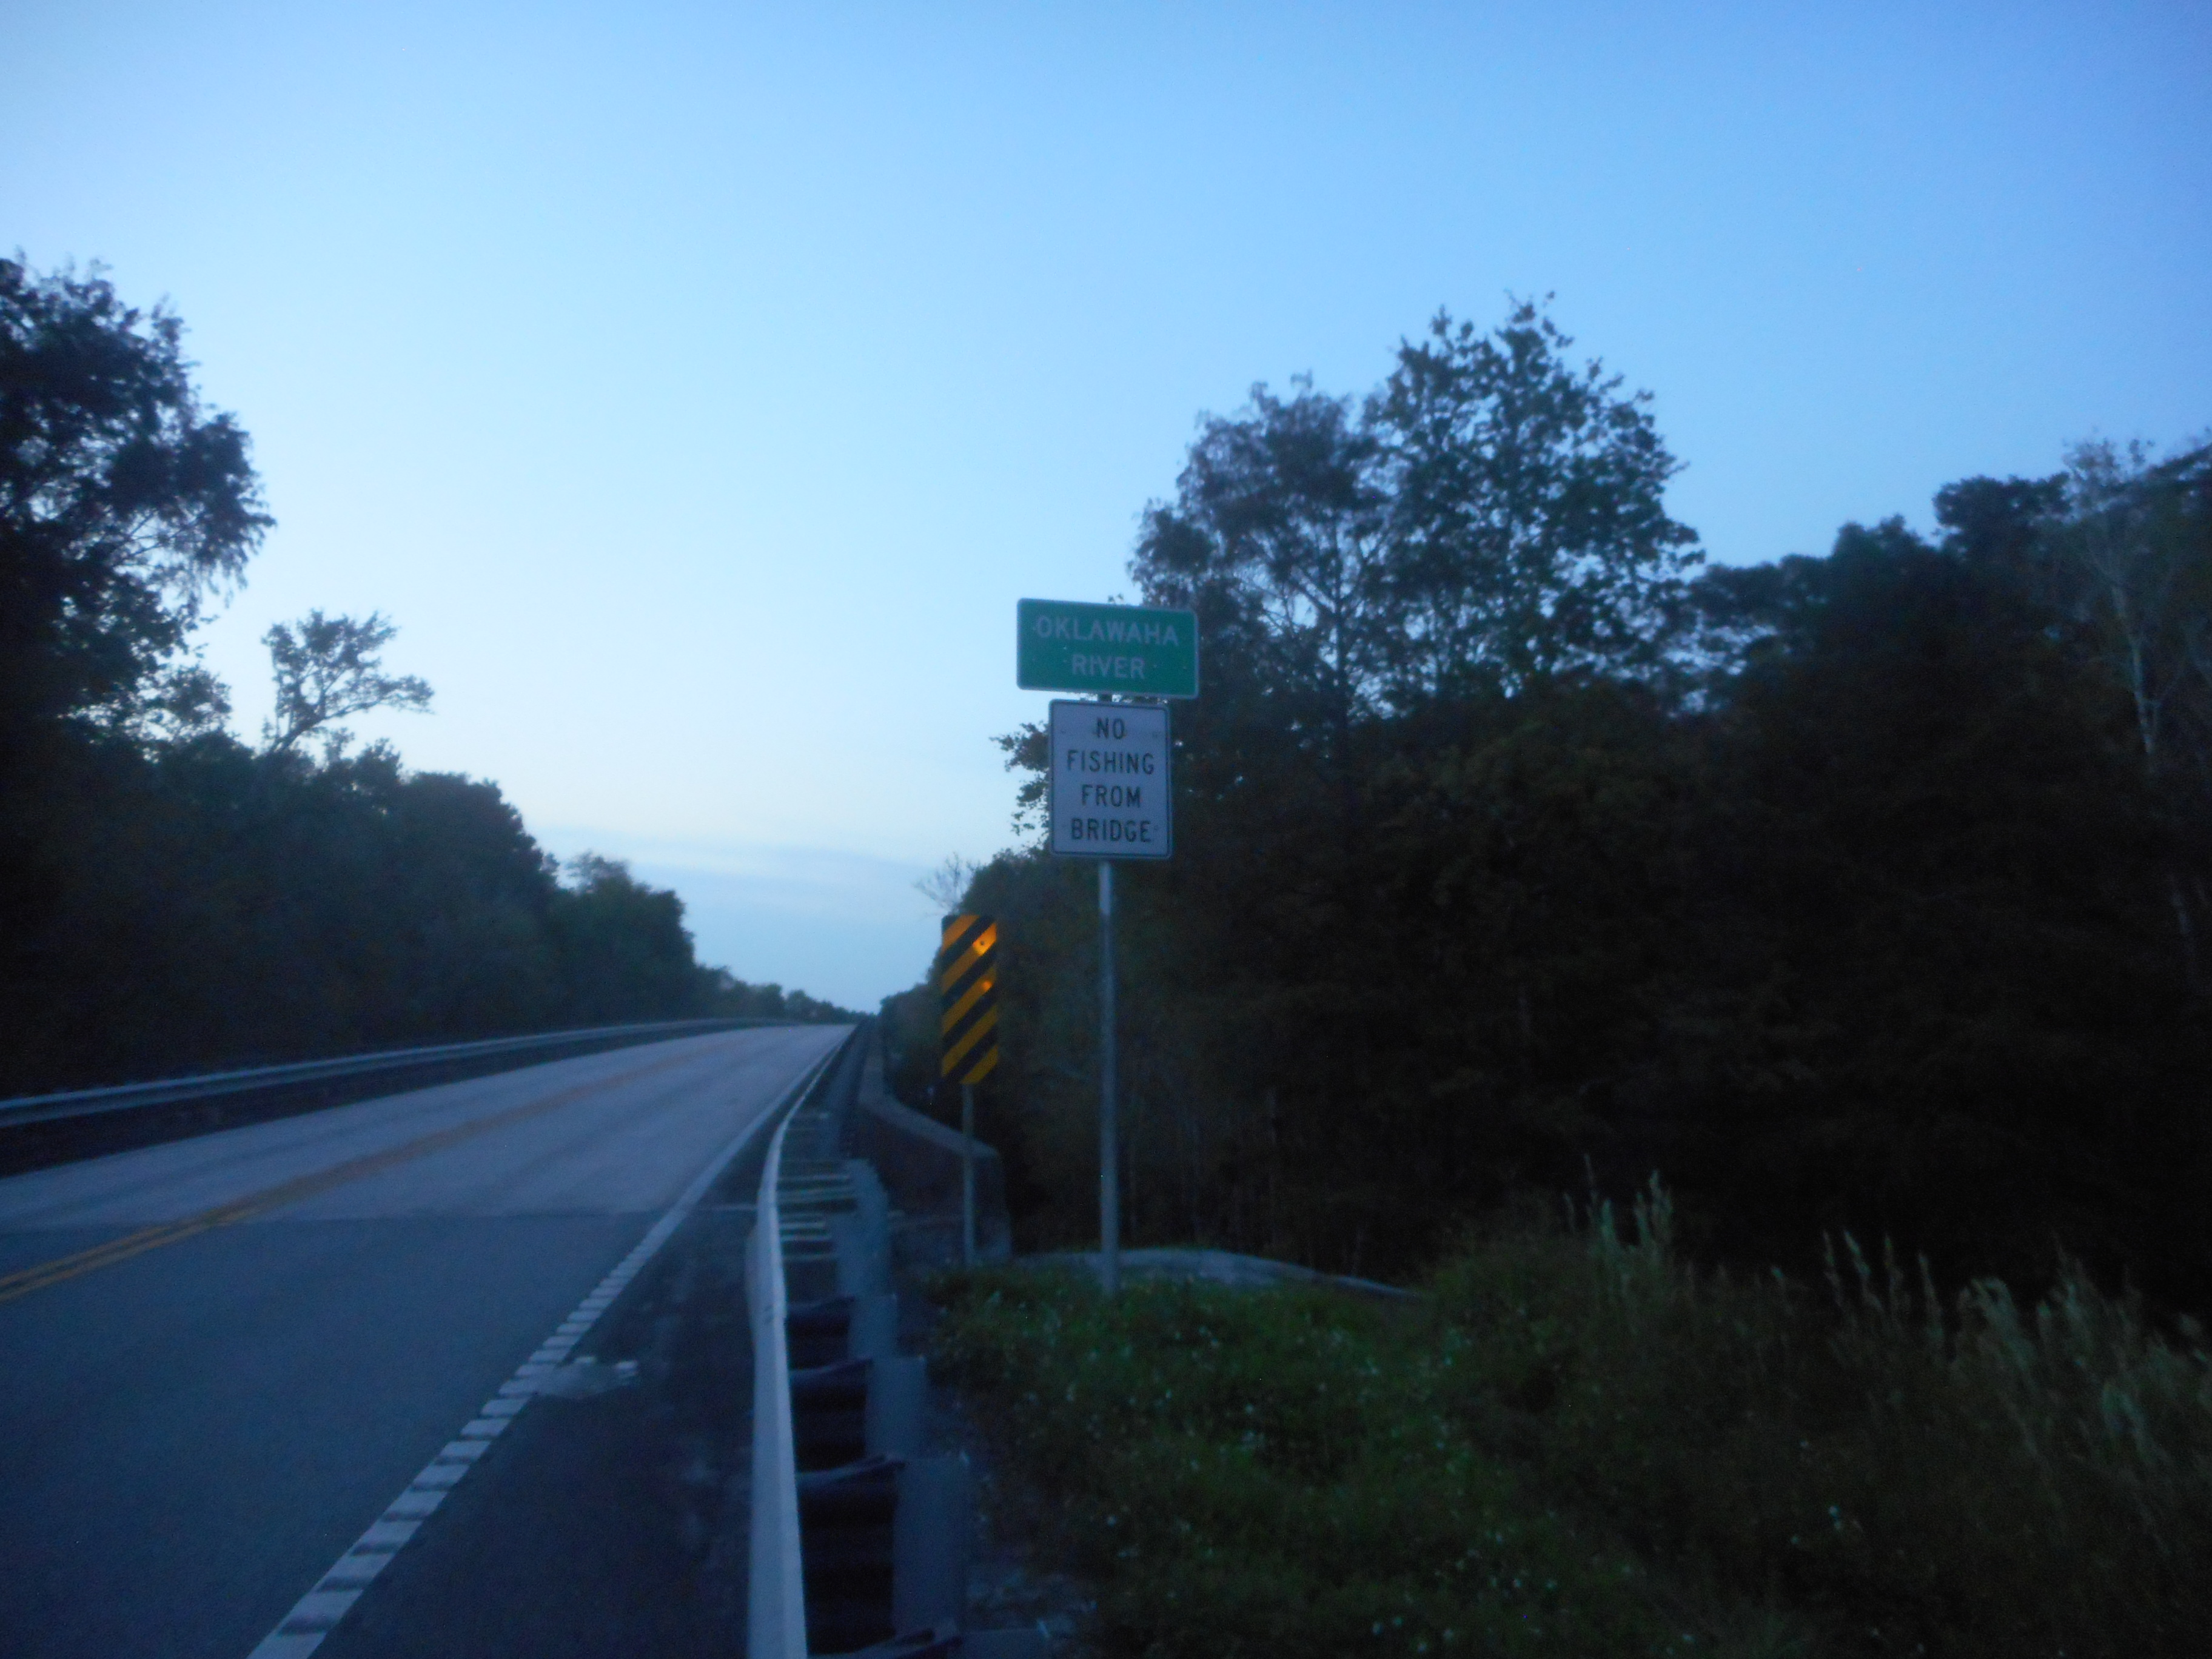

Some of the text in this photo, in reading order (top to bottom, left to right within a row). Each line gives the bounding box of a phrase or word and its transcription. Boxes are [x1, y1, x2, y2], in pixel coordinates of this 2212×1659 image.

[1036, 615, 1179, 647] OKLAWAHA
[1071, 654, 1145, 680] RIVER
[1096, 717, 1125, 739] NO
[1067, 749, 1155, 774] FISHING
[1081, 784, 1141, 808] FROM
[1071, 817, 1151, 842] BRIDGE
